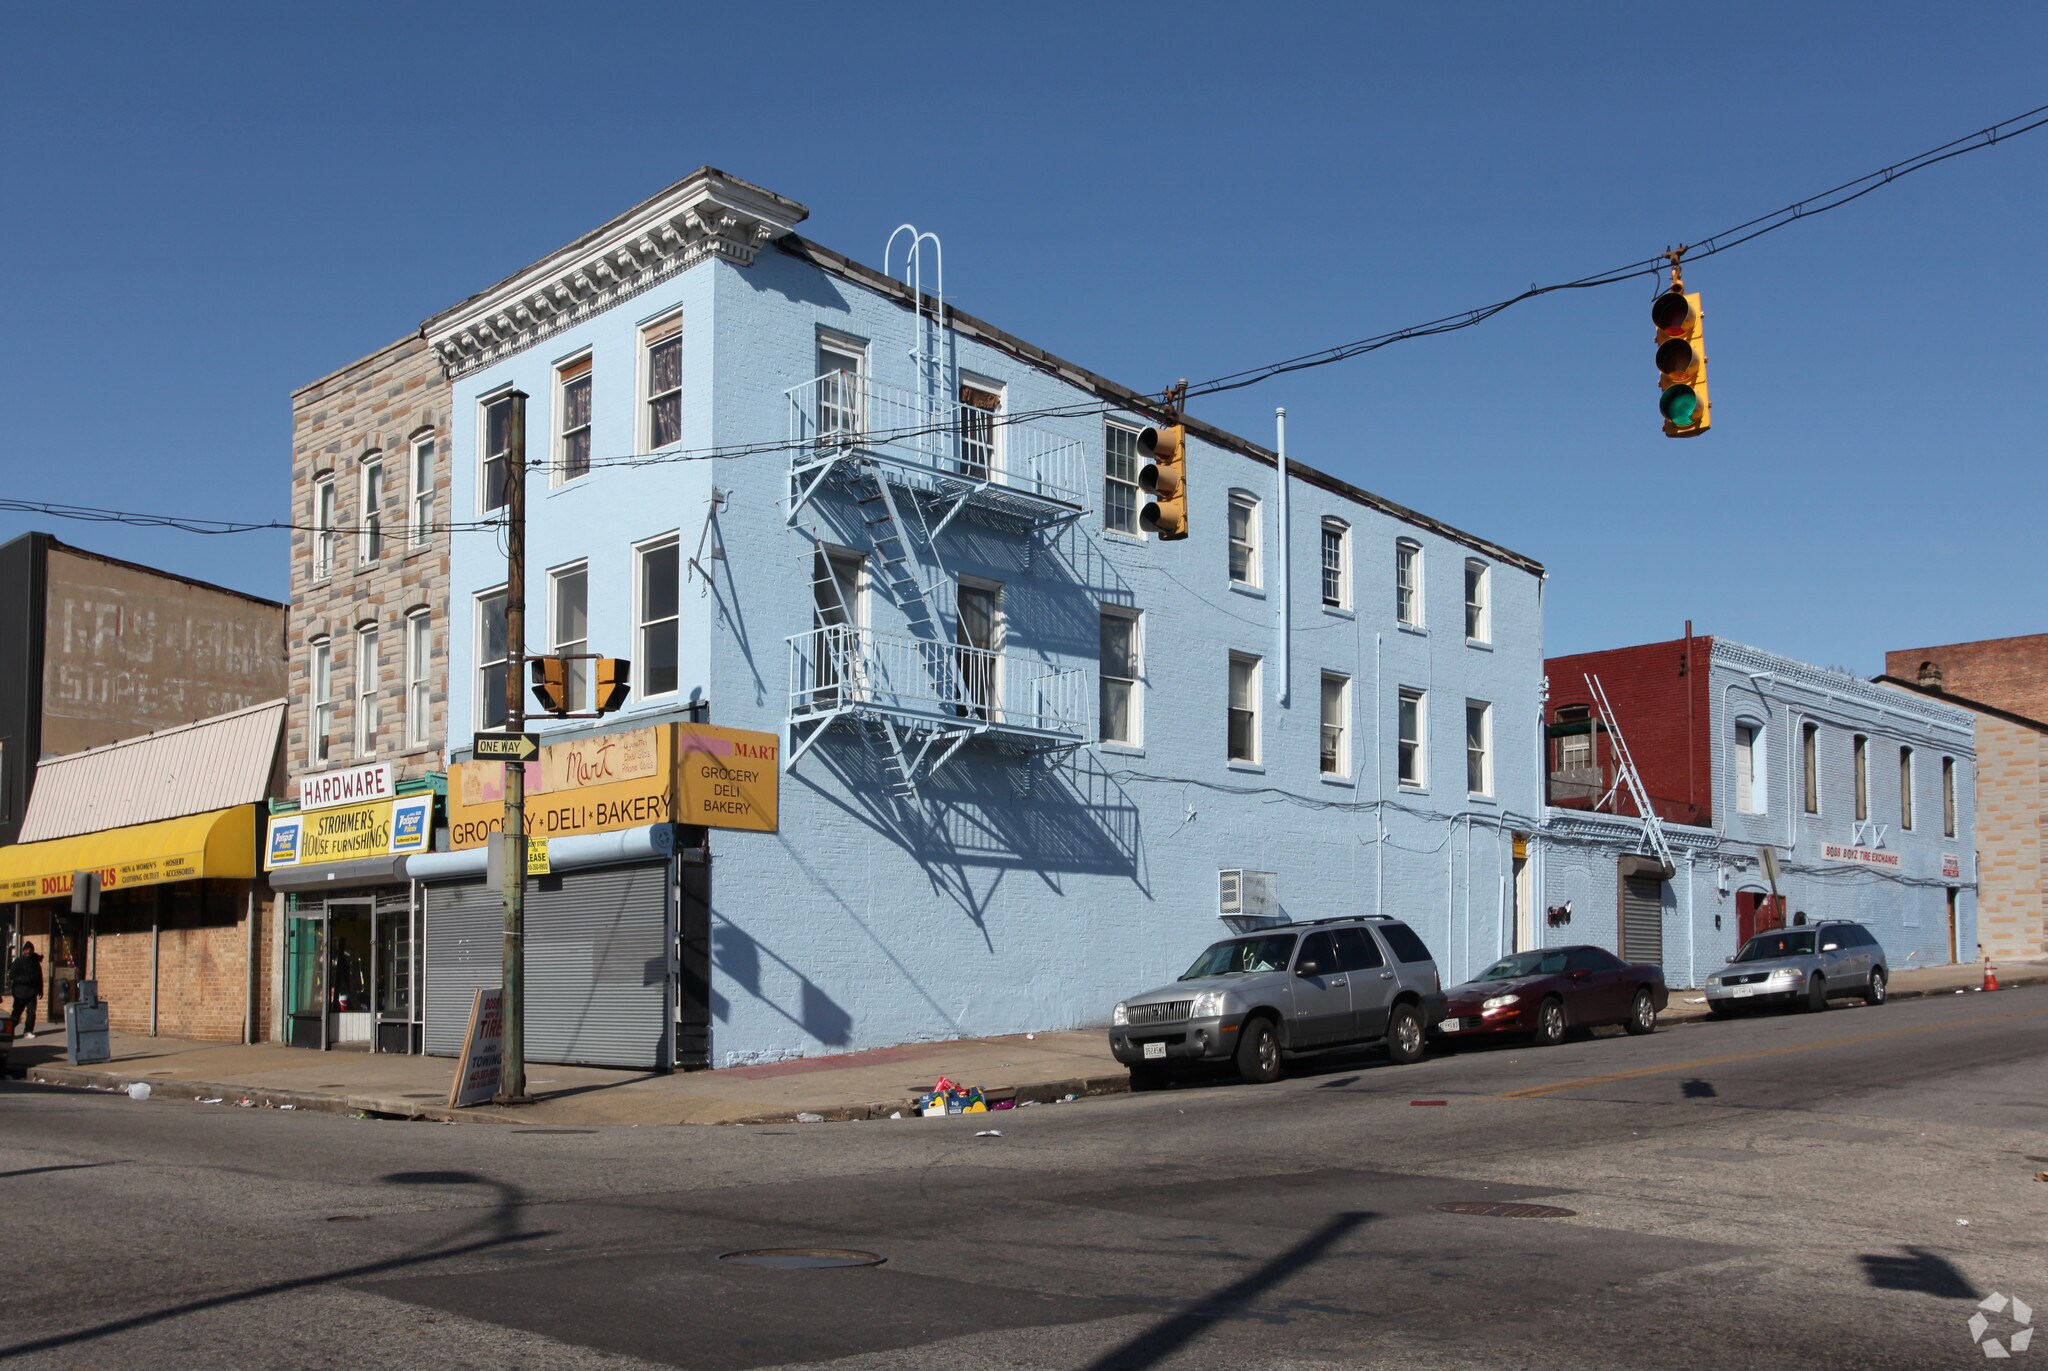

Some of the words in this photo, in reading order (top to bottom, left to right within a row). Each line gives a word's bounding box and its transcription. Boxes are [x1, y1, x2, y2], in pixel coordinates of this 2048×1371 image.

[480, 740, 499, 752] ONE
[501, 741, 520, 753] WAY
[734, 742, 778, 761] MART
[566, 743, 616, 786] Mart
[701, 765, 760, 783] GROCERY
[304, 768, 385, 805] HARDWARE
[714, 783, 740, 798] DELI
[704, 799, 751, 815] BAKERY
[317, 809, 375, 836] STROHMER'S
[453, 813, 536, 844] GROCY
[547, 806, 585, 831] DELI
[597, 793, 674, 826] BAKERY
[301, 831, 330, 857] HOUSE
[331, 820, 390, 853] FURNISHINGS
[165, 857, 185, 867] HOSIERY
[527, 852, 547, 863] EASE
[1826, 846, 1841, 858] BOSS
[1842, 849, 1858, 860] BOYZ
[1859, 851, 1871, 861] TIRE
[1871, 853, 1899, 866] EXCHANGE
[165, 867, 195, 878] ACCESSORIES
[483, 1044, 497, 1054] AND
